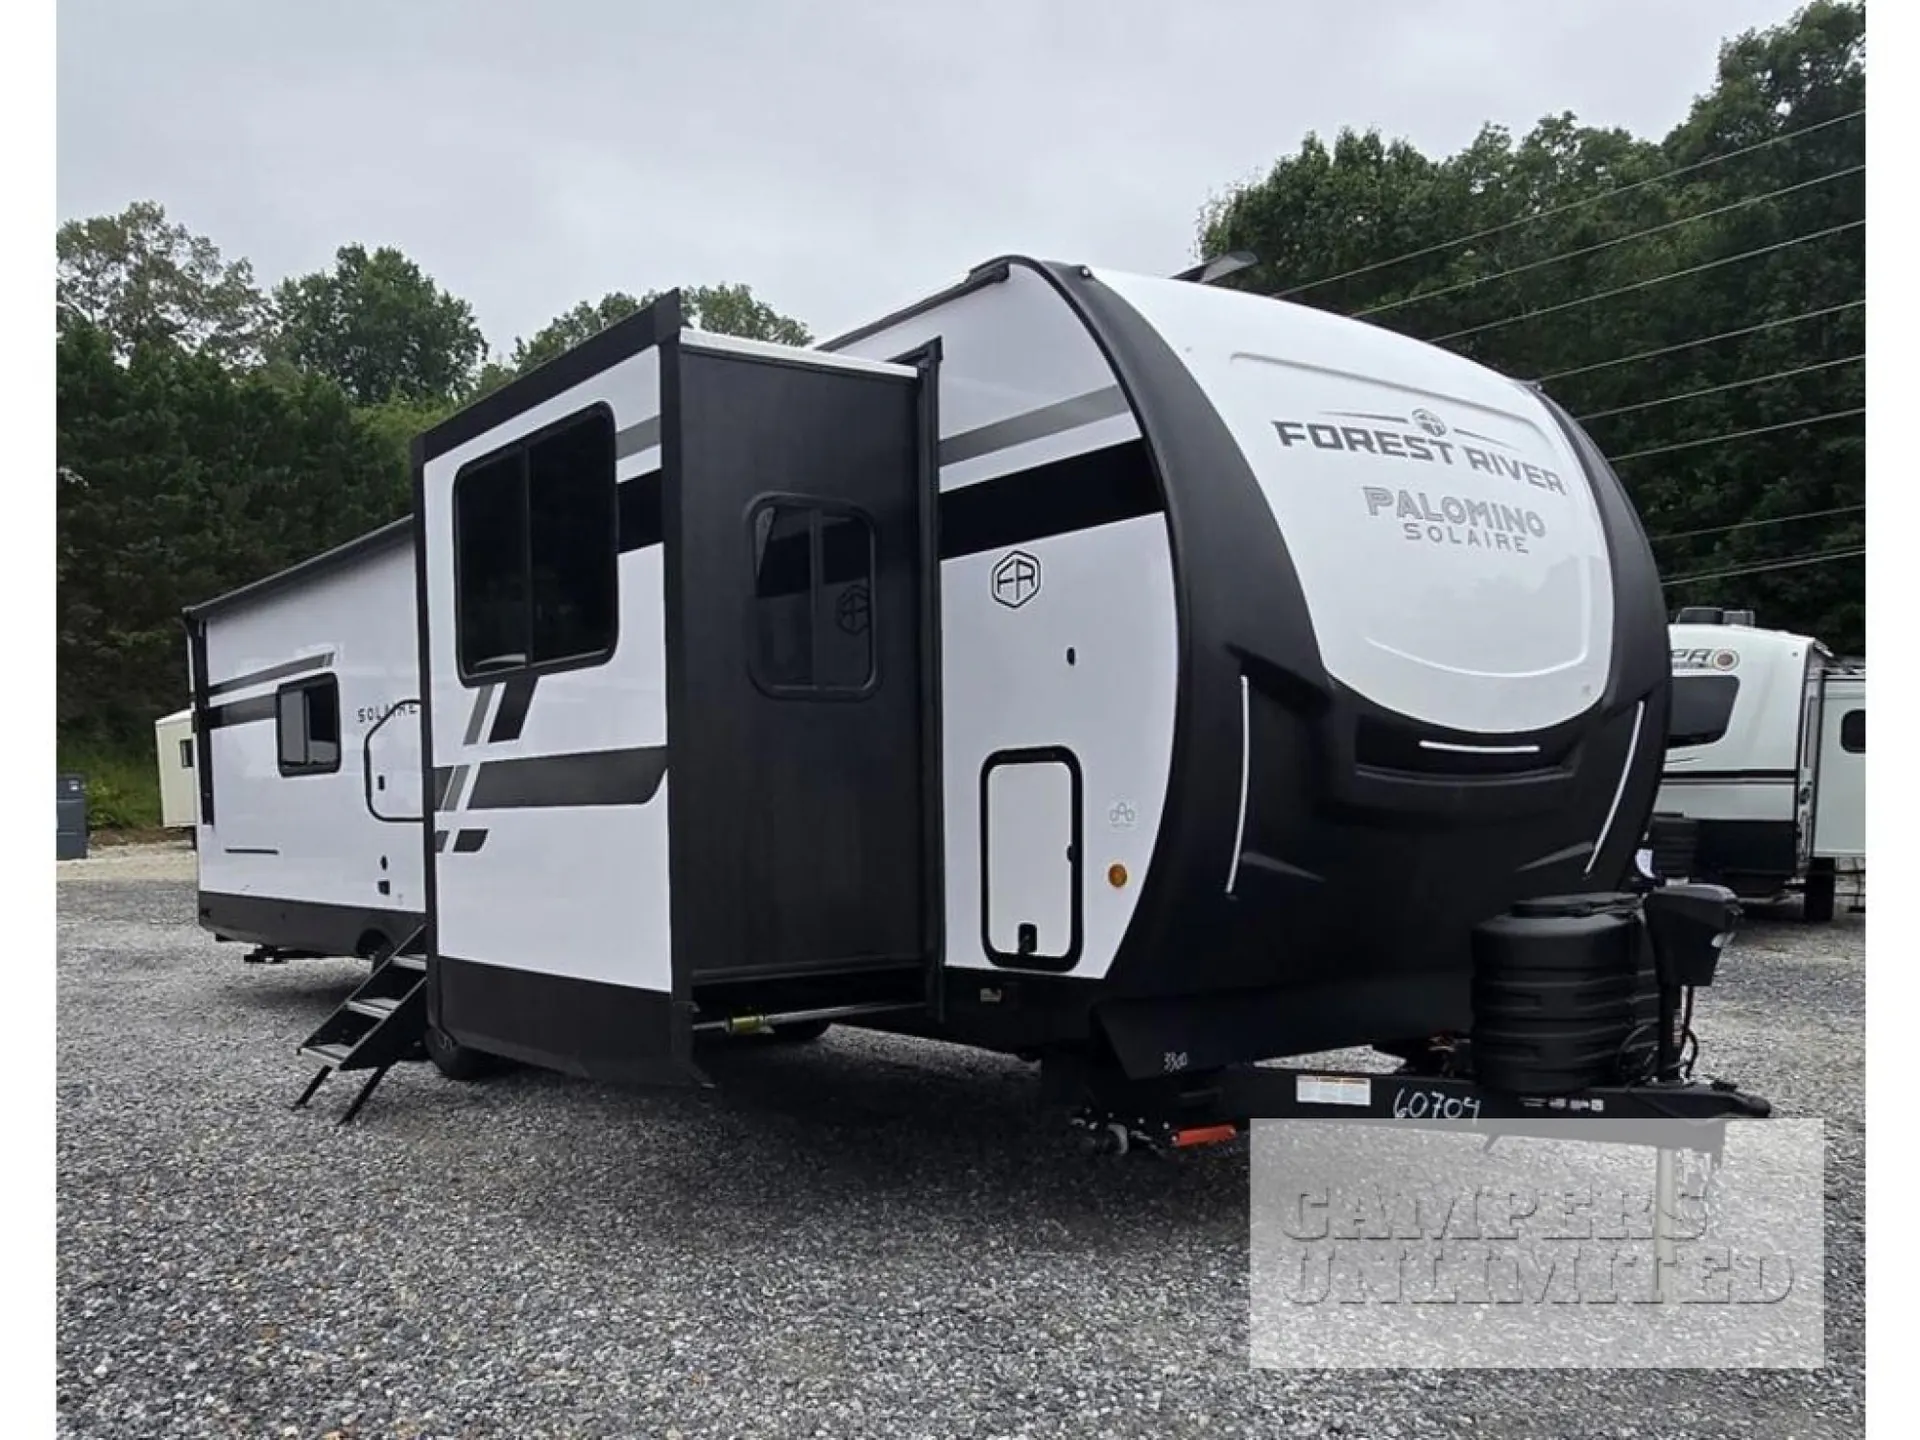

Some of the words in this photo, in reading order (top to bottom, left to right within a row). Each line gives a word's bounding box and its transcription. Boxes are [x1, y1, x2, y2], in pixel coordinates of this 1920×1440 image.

[1271, 419, 1454, 466] FOREST
[1461, 446, 1567, 496] RIVER
[1362, 485, 1547, 538] PALOMINO
[1402, 521, 1530, 554] SOLAIRE
[1393, 1087, 1481, 1126] 60704
